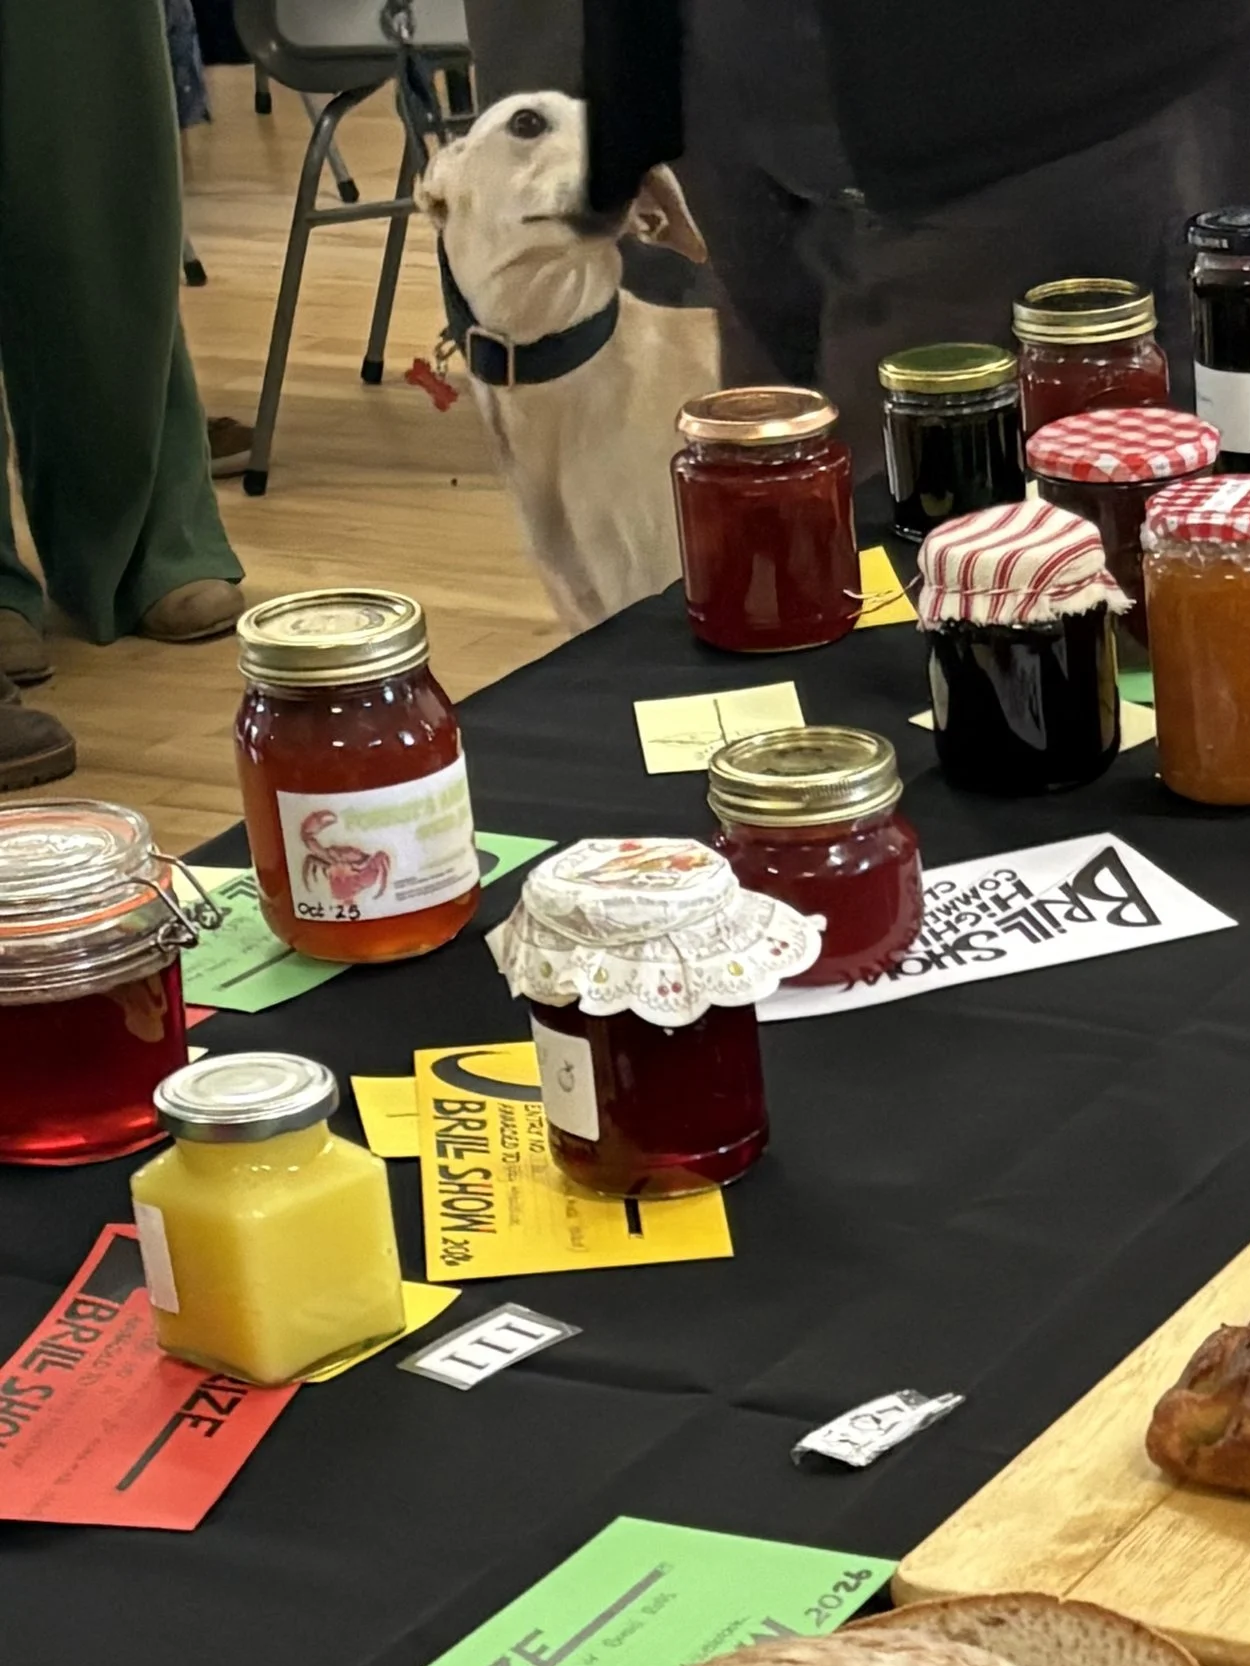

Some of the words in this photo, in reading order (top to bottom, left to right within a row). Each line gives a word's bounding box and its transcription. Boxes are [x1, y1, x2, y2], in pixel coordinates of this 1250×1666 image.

[298, 902, 325, 918] Oct
[432, 1098, 490, 1160] BRILL
[437, 1164, 497, 1235] SHOW
[20, 1298, 120, 1374] BRILL
[440, 1321, 549, 1380] 111
[0, 1375, 54, 1449] SHO
[804, 1566, 873, 1630] 2026
